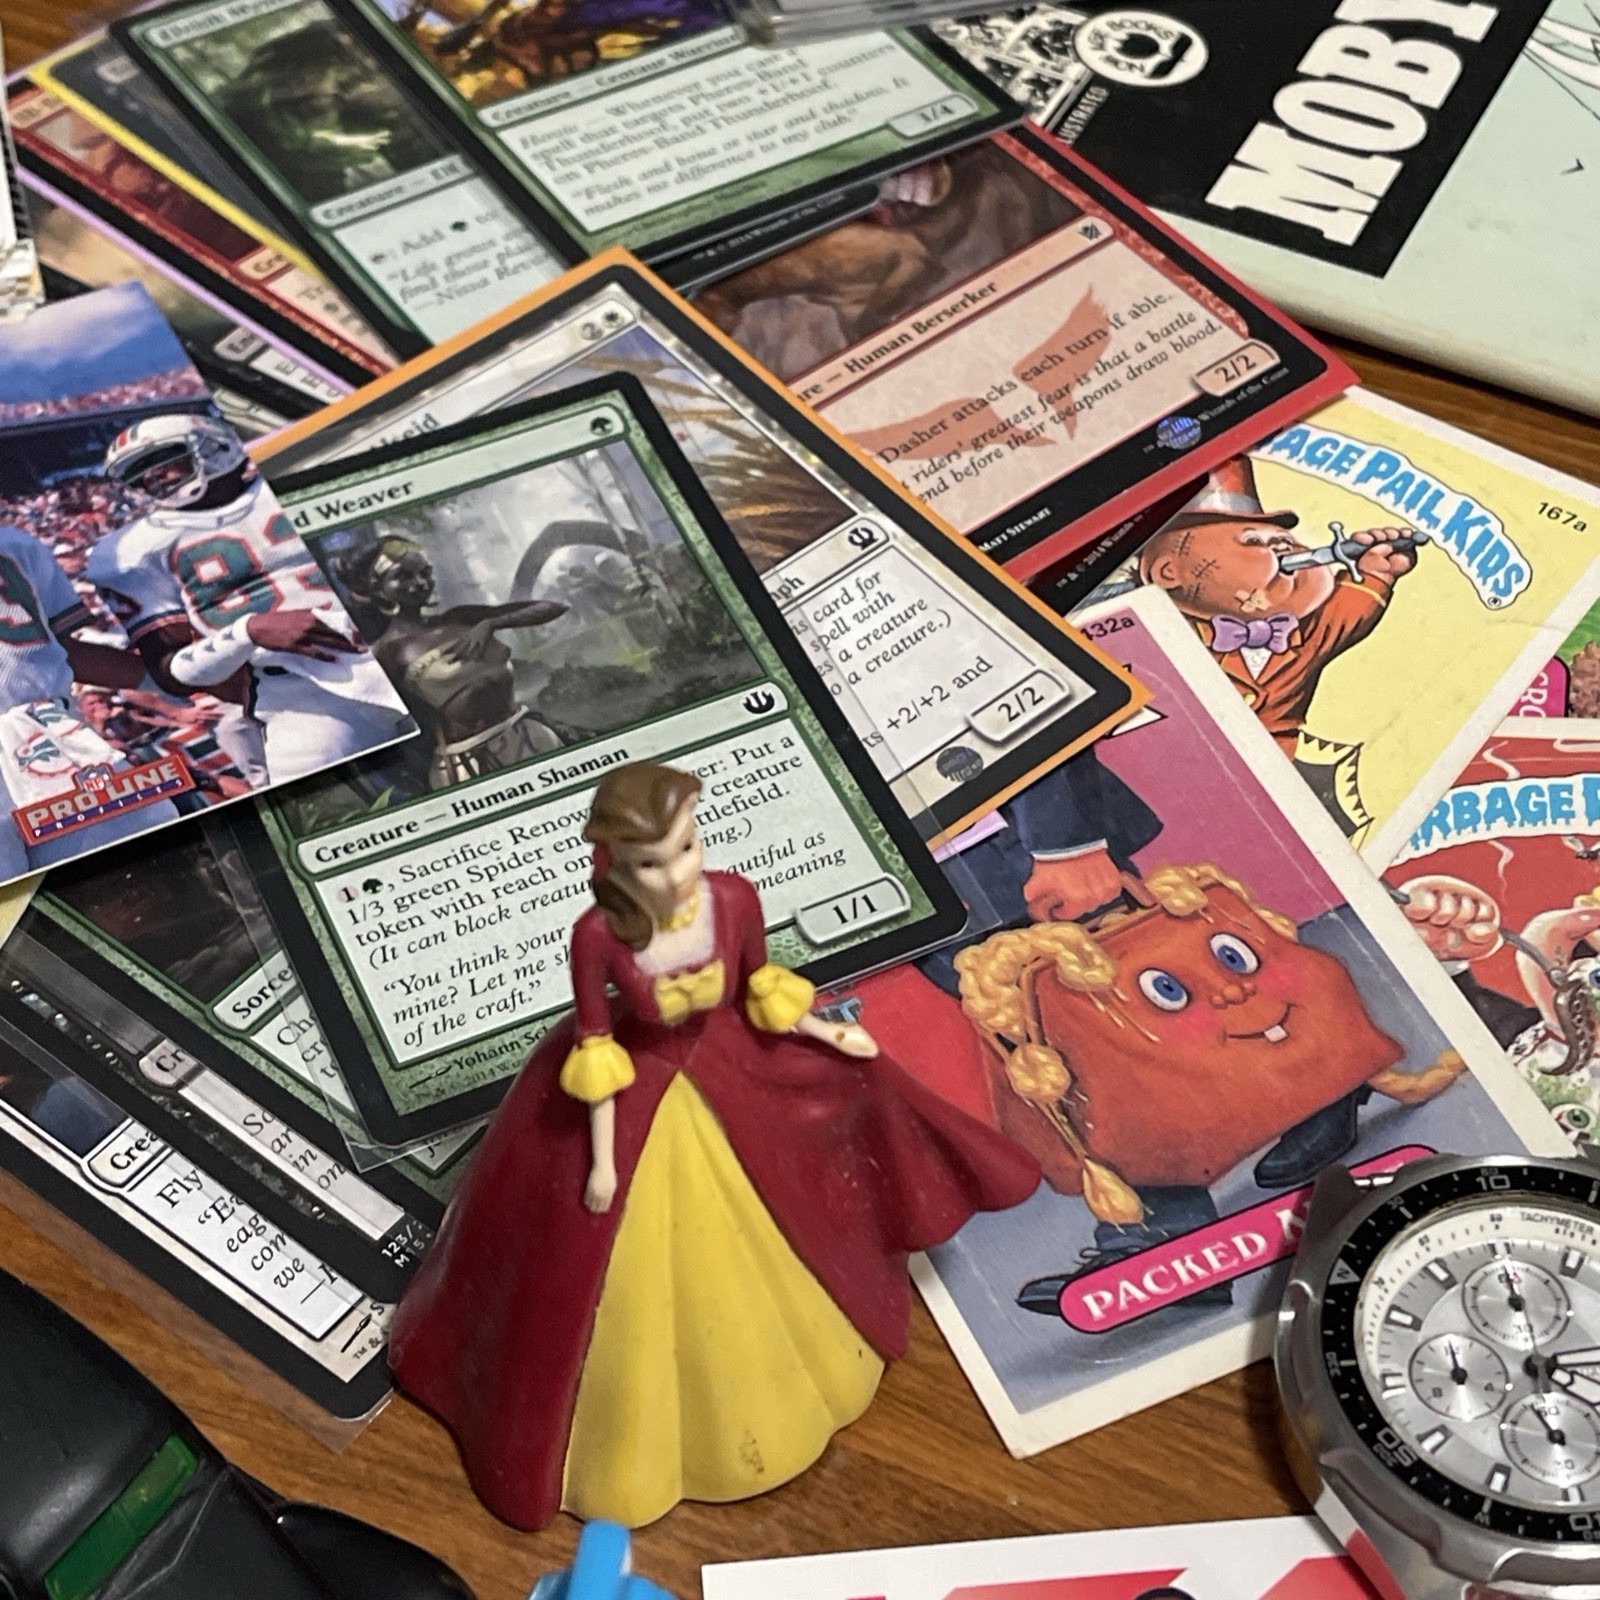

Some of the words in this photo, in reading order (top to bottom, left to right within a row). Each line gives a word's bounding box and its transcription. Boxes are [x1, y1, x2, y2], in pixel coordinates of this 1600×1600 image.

[492, 91, 571, 121] Creature
[596, 58, 667, 86] Centaur
[605, 81, 701, 118] Whenever
[705, 69, 742, 87] you
[745, 52, 783, 73] cast
[817, 44, 896, 77] counters
[844, 332, 914, 374] Human
[910, 281, 998, 336] Berserker
[876, 416, 949, 466] Dasher
[952, 379, 1019, 423] attacks
[1020, 353, 1065, 383] each
[1064, 326, 1110, 356] turn
[1109, 312, 1127, 332] if
[1127, 291, 1174, 322] able.
[952, 448, 1005, 483] before
[1005, 418, 1047, 452] their
[1050, 379, 1123, 428] weapons
[1126, 350, 1169, 382] draw
[1170, 319, 1223, 354] blood.
[970, 404, 1036, 453] greatest
[1037, 382, 1072, 414] fear
[1075, 371, 1092, 387] is
[1094, 349, 1131, 377] that
[1134, 341, 1148, 354] a
[1149, 311, 1197, 344] battle
[1214, 353, 1258, 385] 2/2
[316, 480, 415, 524] Weaver
[1268, 427, 1366, 478] AGE
[1353, 449, 1445, 531] PAIL
[1440, 499, 1525, 599] KIDS
[1538, 501, 1589, 534] 167a
[810, 617, 850, 653] spell
[852, 589, 896, 626] with
[812, 586, 855, 624] card
[856, 569, 882, 600] for
[1079, 615, 1136, 642] 132a
[839, 648, 853, 664] a
[855, 598, 929, 652] creature
[847, 669, 862, 686] a
[865, 608, 953, 675] creature.)
[885, 684, 951, 732] +2/+2
[952, 654, 995, 690] and
[997, 685, 1045, 723] 2/2
[26, 791, 99, 830] PRO
[106, 761, 181, 802] LINE
[314, 820, 421, 865] Creature
[450, 782, 536, 818] Human
[536, 748, 631, 788] Shaman
[398, 839, 503, 884] Sacrifice
[732, 743, 776, 767] Put
[779, 734, 796, 750] a
[346, 900, 386, 927] 1/3
[393, 878, 461, 914] green
[465, 842, 545, 886] Spider
[710, 753, 804, 798] creature
[354, 913, 426, 947] token
[429, 890, 486, 921] with
[494, 865, 558, 900] reach
[368, 945, 400, 971] (It
[406, 930, 449, 954] can
[454, 905, 513, 938] block
[383, 971, 442, 998] “You
[449, 943, 510, 979] think
[515, 925, 567, 960] your
[803, 831, 827, 851] as
[393, 985, 459, 1025] mine?
[468, 971, 506, 999] Let
[513, 959, 548, 982] me
[753, 847, 849, 892] meaning
[831, 892, 879, 926] 1/1
[403, 1021, 426, 1047] of
[432, 1010, 468, 1037] the
[474, 979, 542, 1020] craft.”
[453, 1035, 522, 1071] Yohann
[1475, 1174, 1511, 1191] 10
[1519, 1211, 1594, 1236] TACHYMETER
[273, 1257, 306, 1290] we
[1081, 1230, 1269, 1322] PACKED
